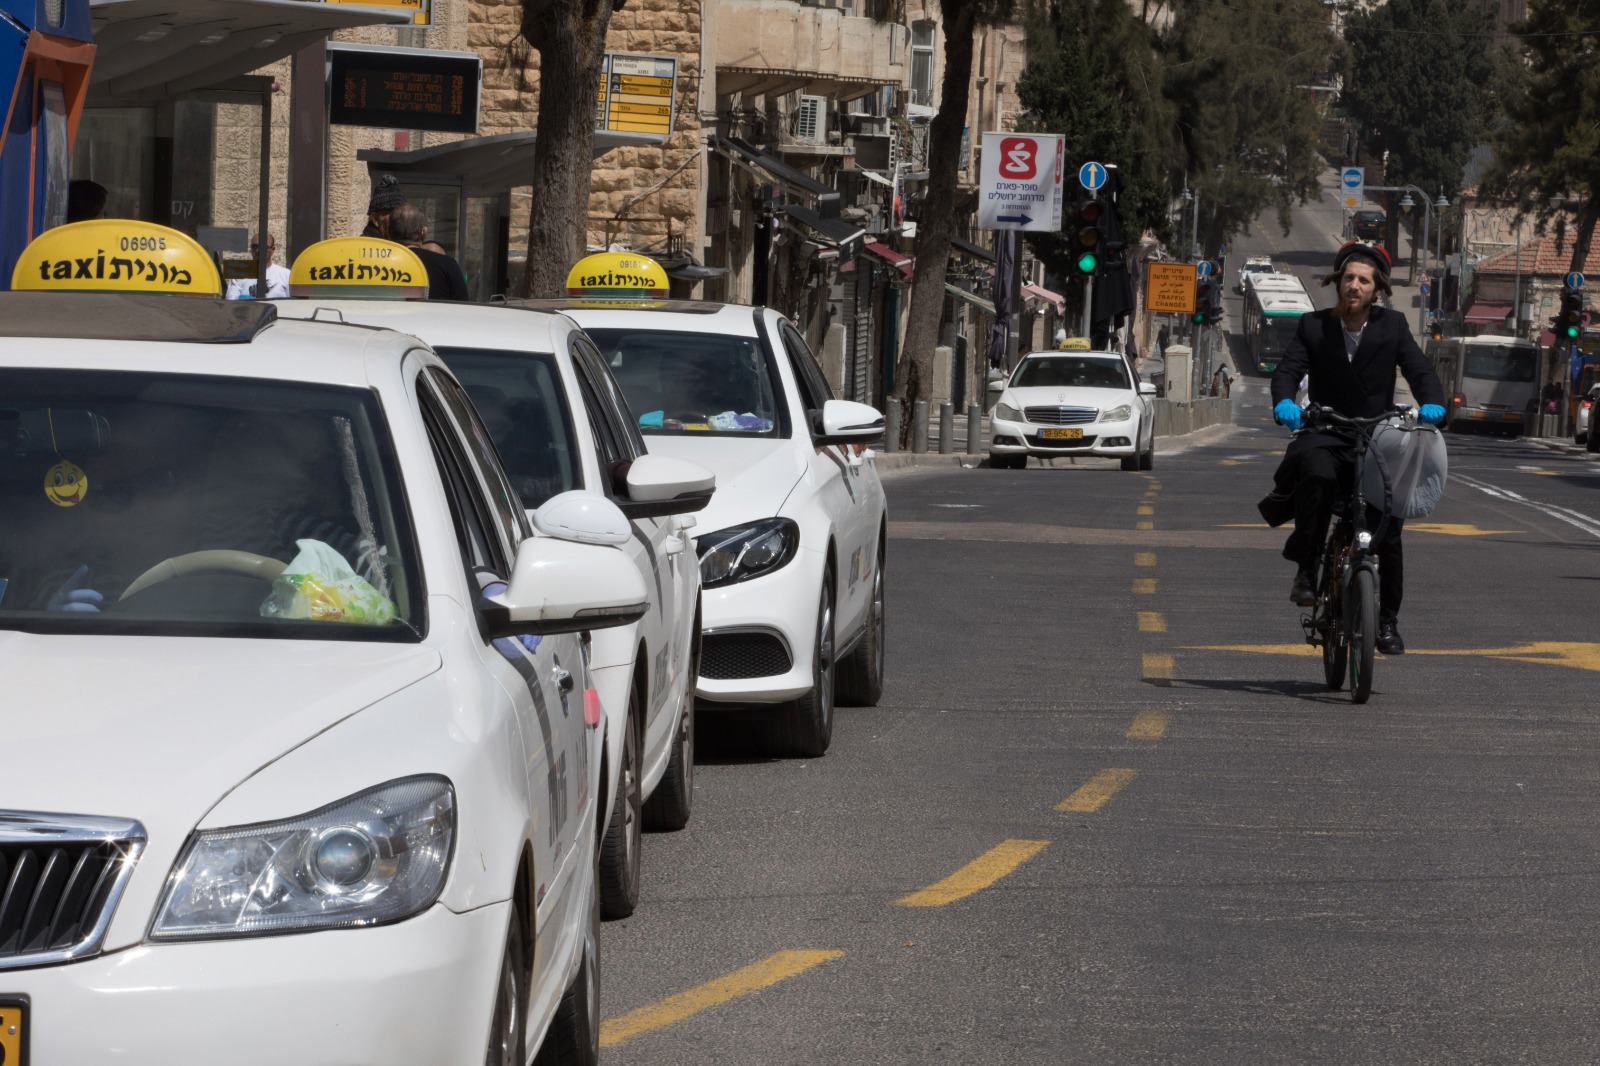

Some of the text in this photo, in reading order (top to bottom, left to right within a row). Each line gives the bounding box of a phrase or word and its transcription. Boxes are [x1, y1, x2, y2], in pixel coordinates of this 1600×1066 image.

[452, 75, 464, 84] 78
[996, 182, 1038, 192] סופר-פארם
[988, 192, 1016, 200] ירושלים
[120, 236, 166, 251] 06905
[362, 248, 392, 258] 11107
[39, 249, 192, 285] taxi מונית
[310, 259, 412, 283] taxi מונית
[580, 270, 656, 287] taxi מונית
